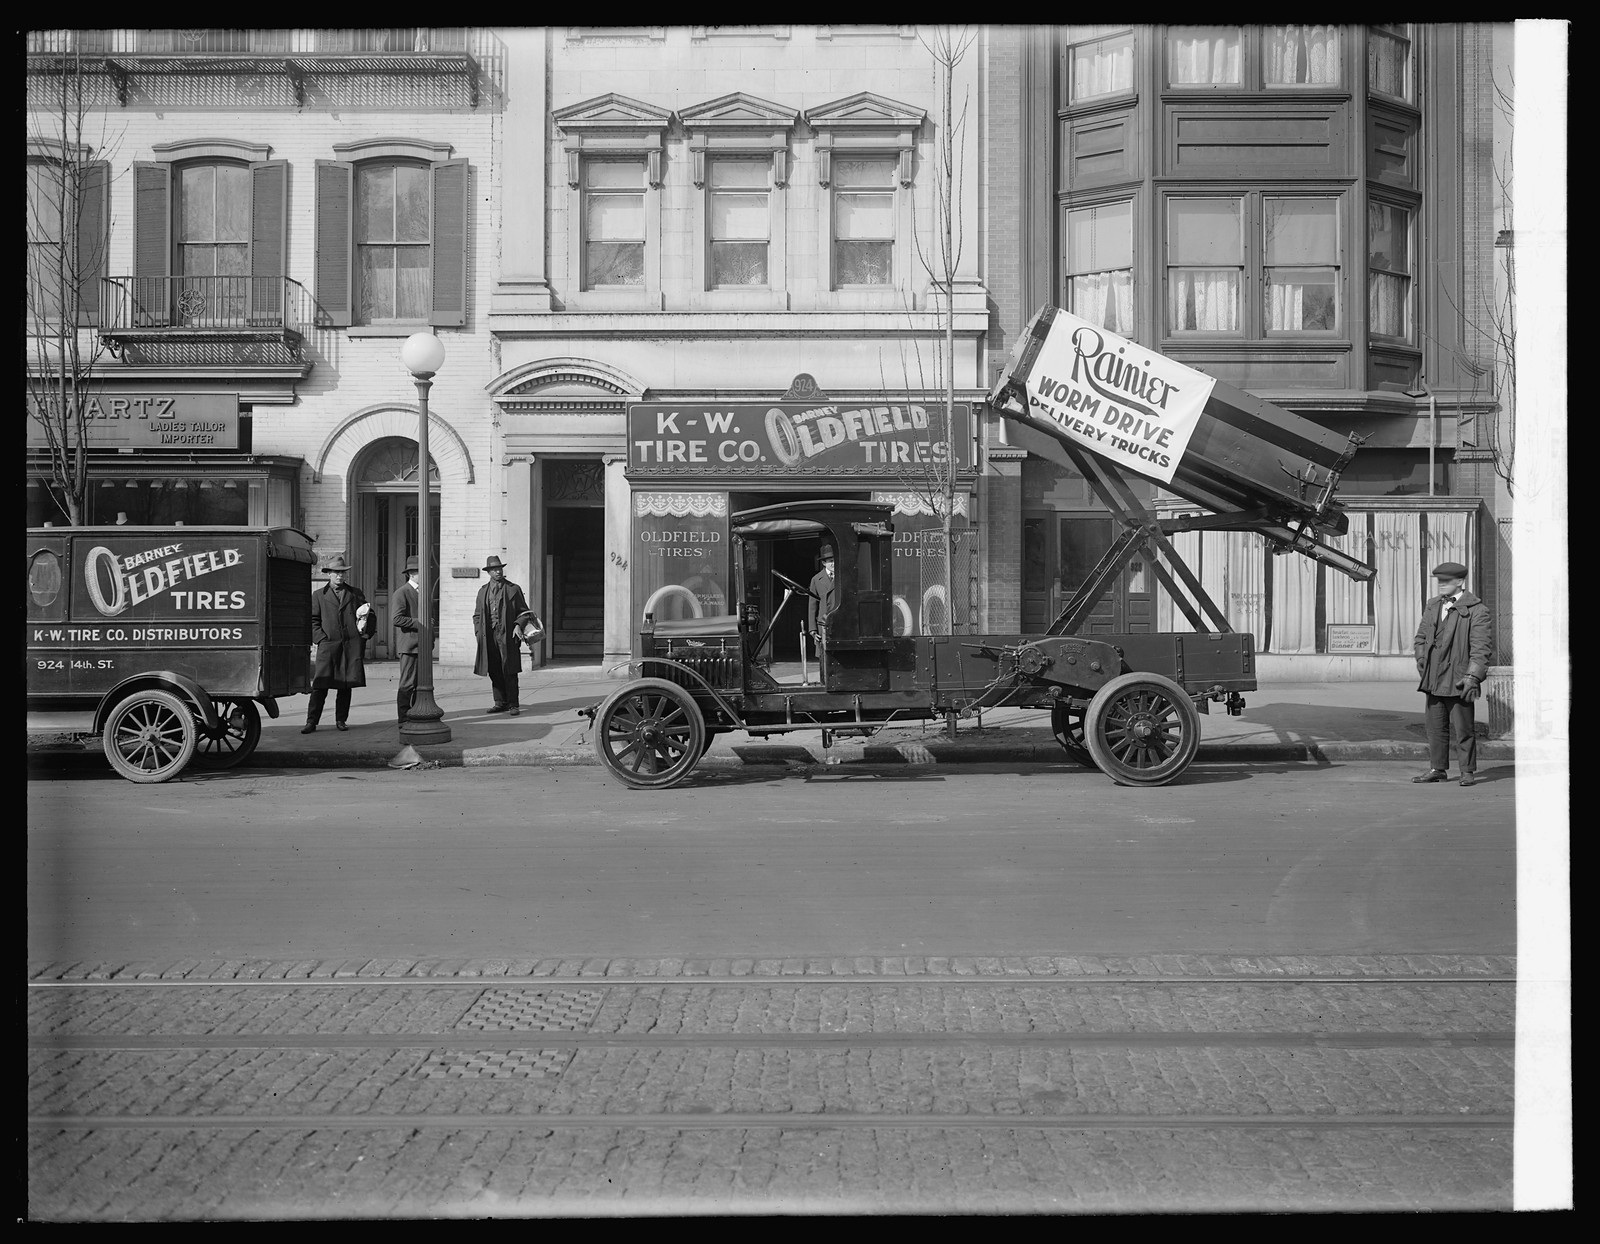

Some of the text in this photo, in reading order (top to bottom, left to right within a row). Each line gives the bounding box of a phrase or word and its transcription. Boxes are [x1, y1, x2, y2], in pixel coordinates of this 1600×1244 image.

[1071, 327, 1180, 417] Rainier
[794, 378, 814, 392] 924
[792, 405, 839, 425] BARNEY
[1037, 375, 1175, 449] WORM DRIVE
[149, 422, 225, 433] LADIES TAILOR
[765, 404, 931, 466] OLDFIELD
[1029, 396, 1171, 468] DELIVERY TRUCKS
[160, 434, 214, 444] IMPORTER
[634, 439, 767, 463] TIRE CO.
[640, 531, 721, 543] OLDFIELD
[1352, 530, 1412, 551] PARK
[123, 543, 182, 571] BARNEY
[610, 551, 629, 572] 924
[657, 547, 703, 557] TIRES
[894, 547, 946, 557] TUBES
[85, 546, 241, 617] OLDFIELD
[170, 590, 246, 610] TIRES
[33, 627, 243, 641] K-W. TIRE CO. DISTRIBUTORS
[37, 660, 65, 670] 924
[97, 659, 115, 669] ST.
